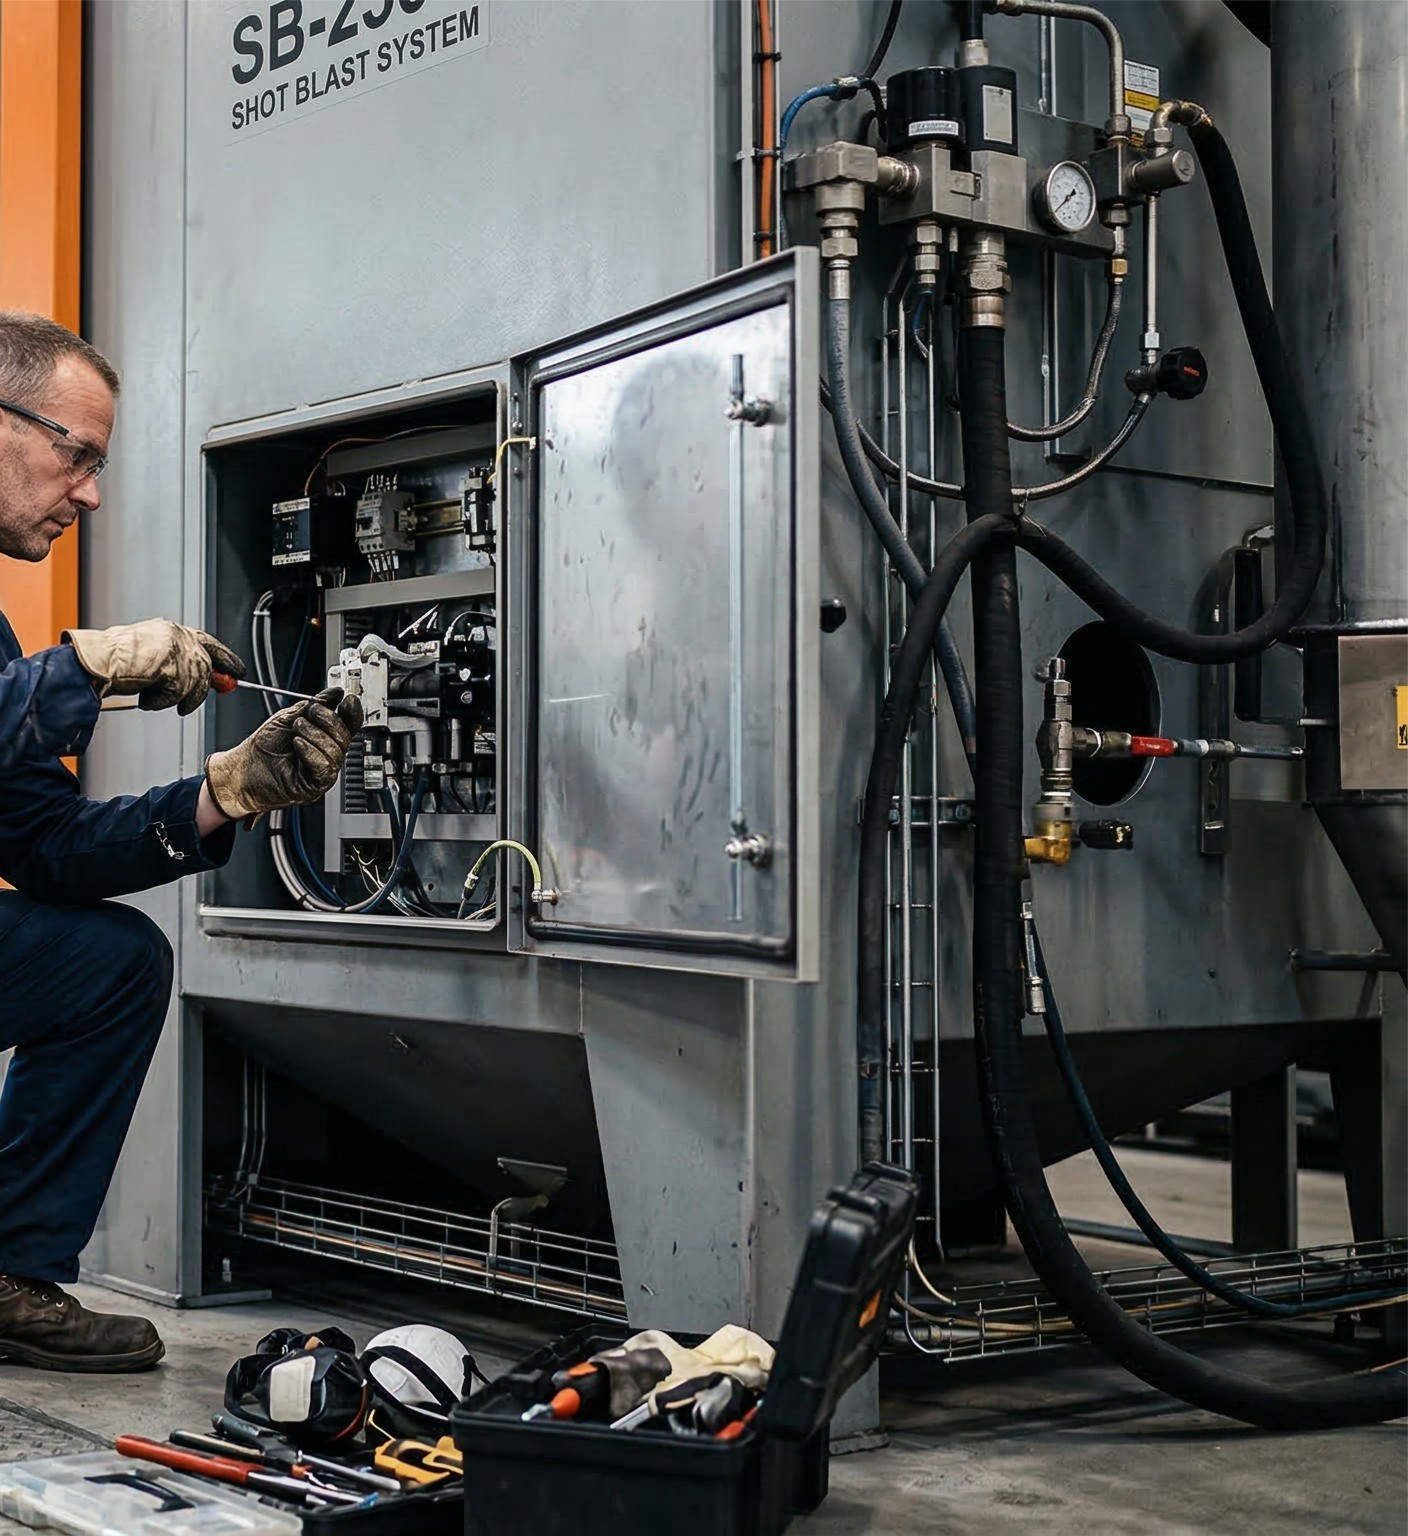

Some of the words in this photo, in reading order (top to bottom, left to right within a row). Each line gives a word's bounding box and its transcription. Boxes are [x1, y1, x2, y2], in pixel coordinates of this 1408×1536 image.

[231, 82, 289, 130] SHOT
[295, 49, 371, 106] BLAST
[377, 5, 479, 73] SYSTEM
